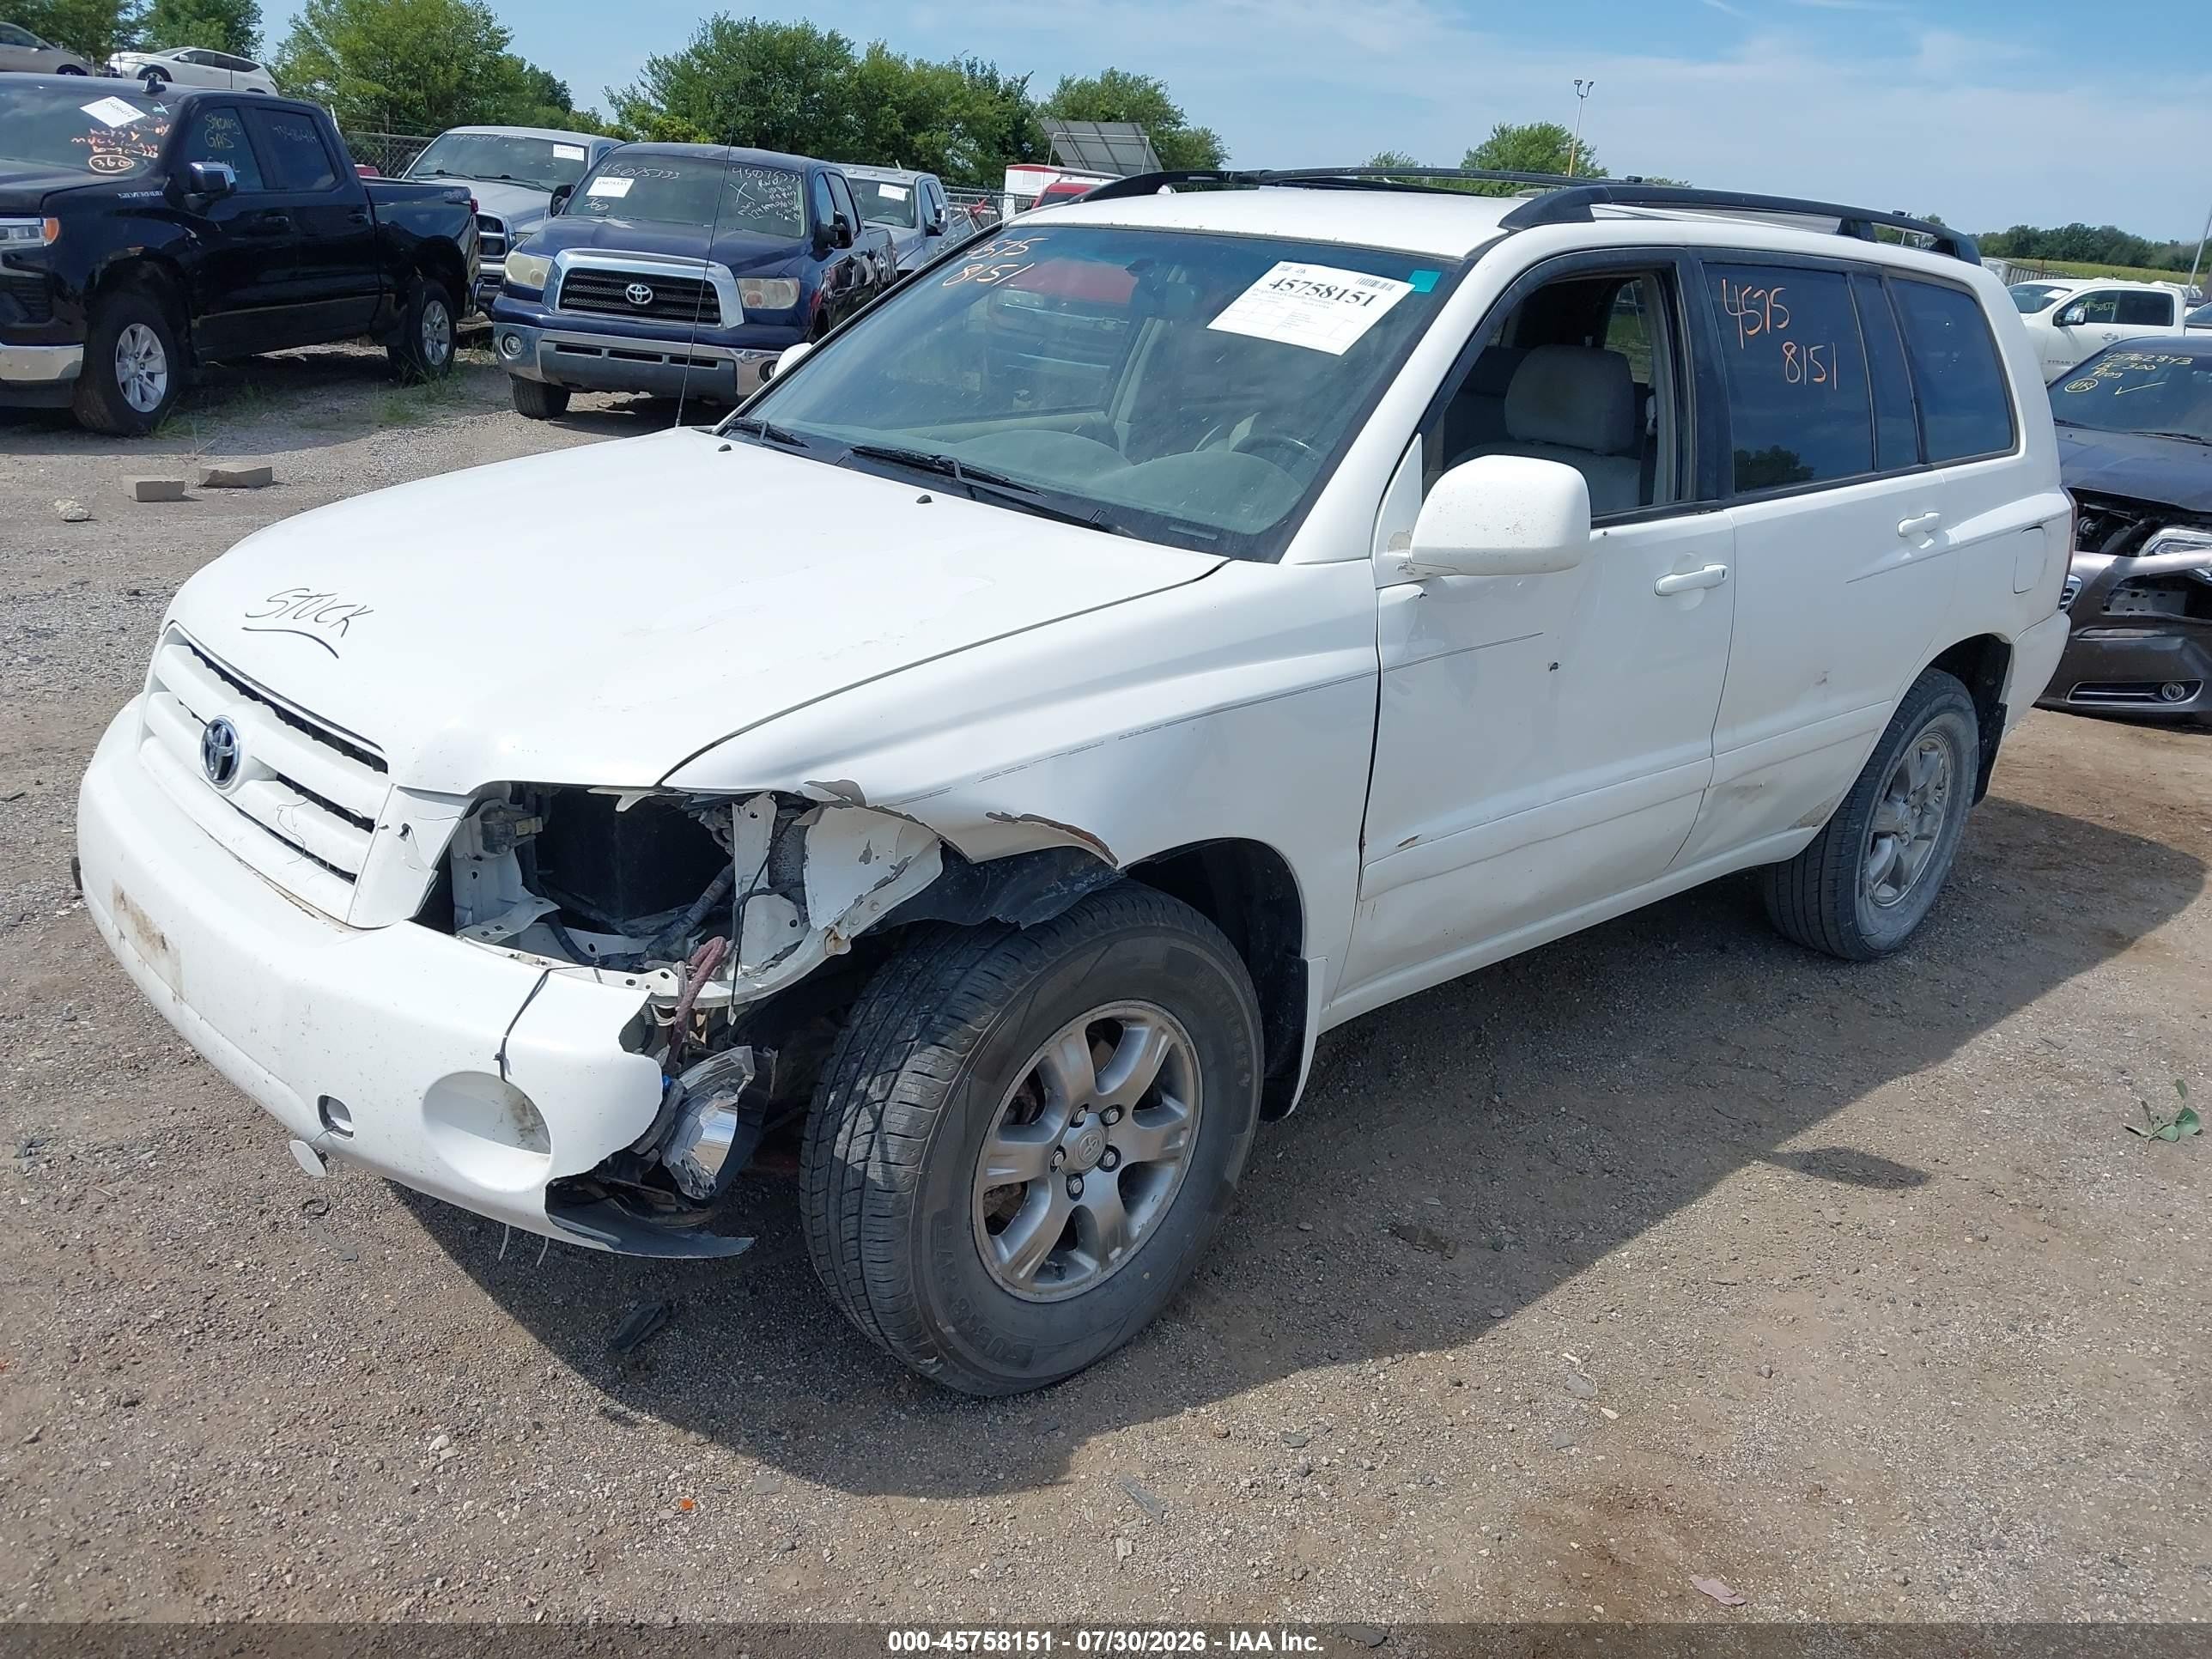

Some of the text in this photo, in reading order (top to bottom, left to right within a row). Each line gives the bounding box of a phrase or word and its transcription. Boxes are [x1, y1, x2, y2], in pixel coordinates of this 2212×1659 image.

[601, 161, 681, 179] 45075333
[732, 167, 802, 184] 45075333
[942, 262, 1036, 288] 8151
[1269, 277, 1377, 307] 45758151
[1722, 278, 1790, 350] 4575
[1783, 341, 1838, 391] 8151
[244, 587, 374, 638] STUCK
